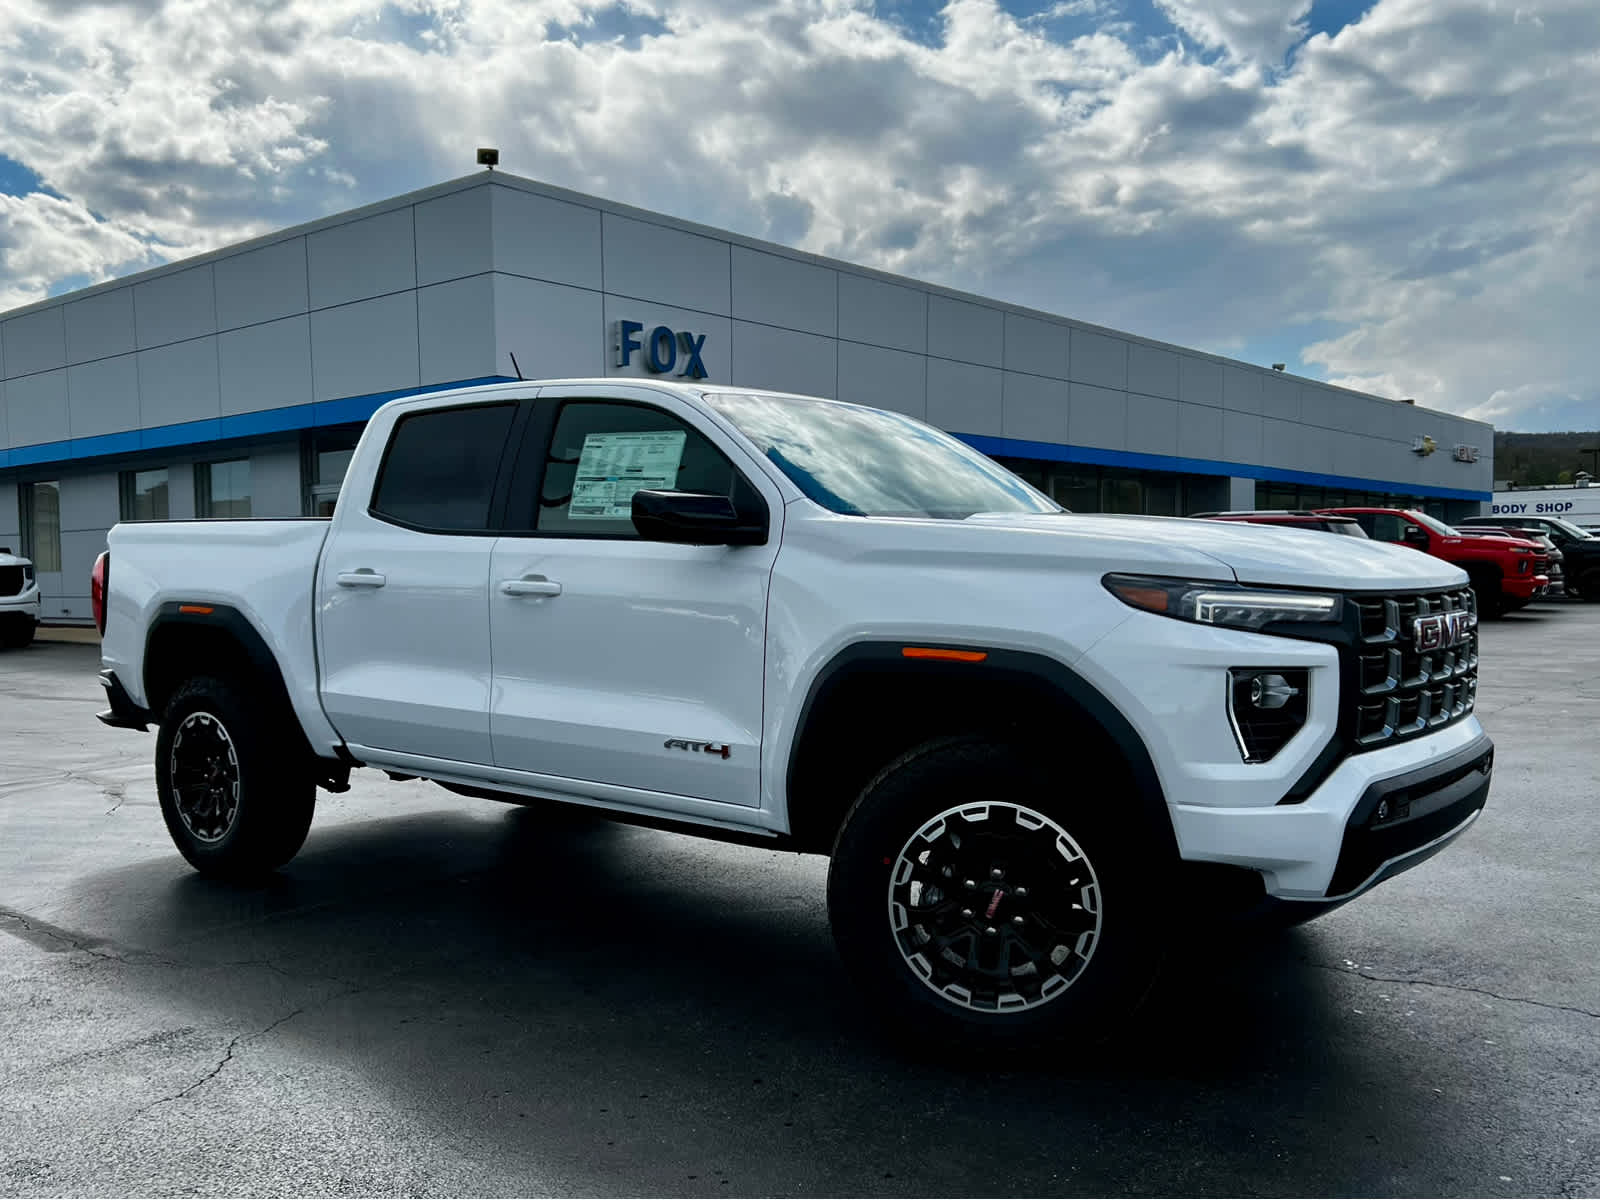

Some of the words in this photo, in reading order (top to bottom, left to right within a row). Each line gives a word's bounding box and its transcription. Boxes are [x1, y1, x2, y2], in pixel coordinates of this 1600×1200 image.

[617, 319, 709, 378] FOX
[1492, 503, 1527, 514] BODY
[1536, 502, 1573, 513] SHOP
[1414, 611, 1478, 654] GMC
[664, 738, 731, 760] AT4
